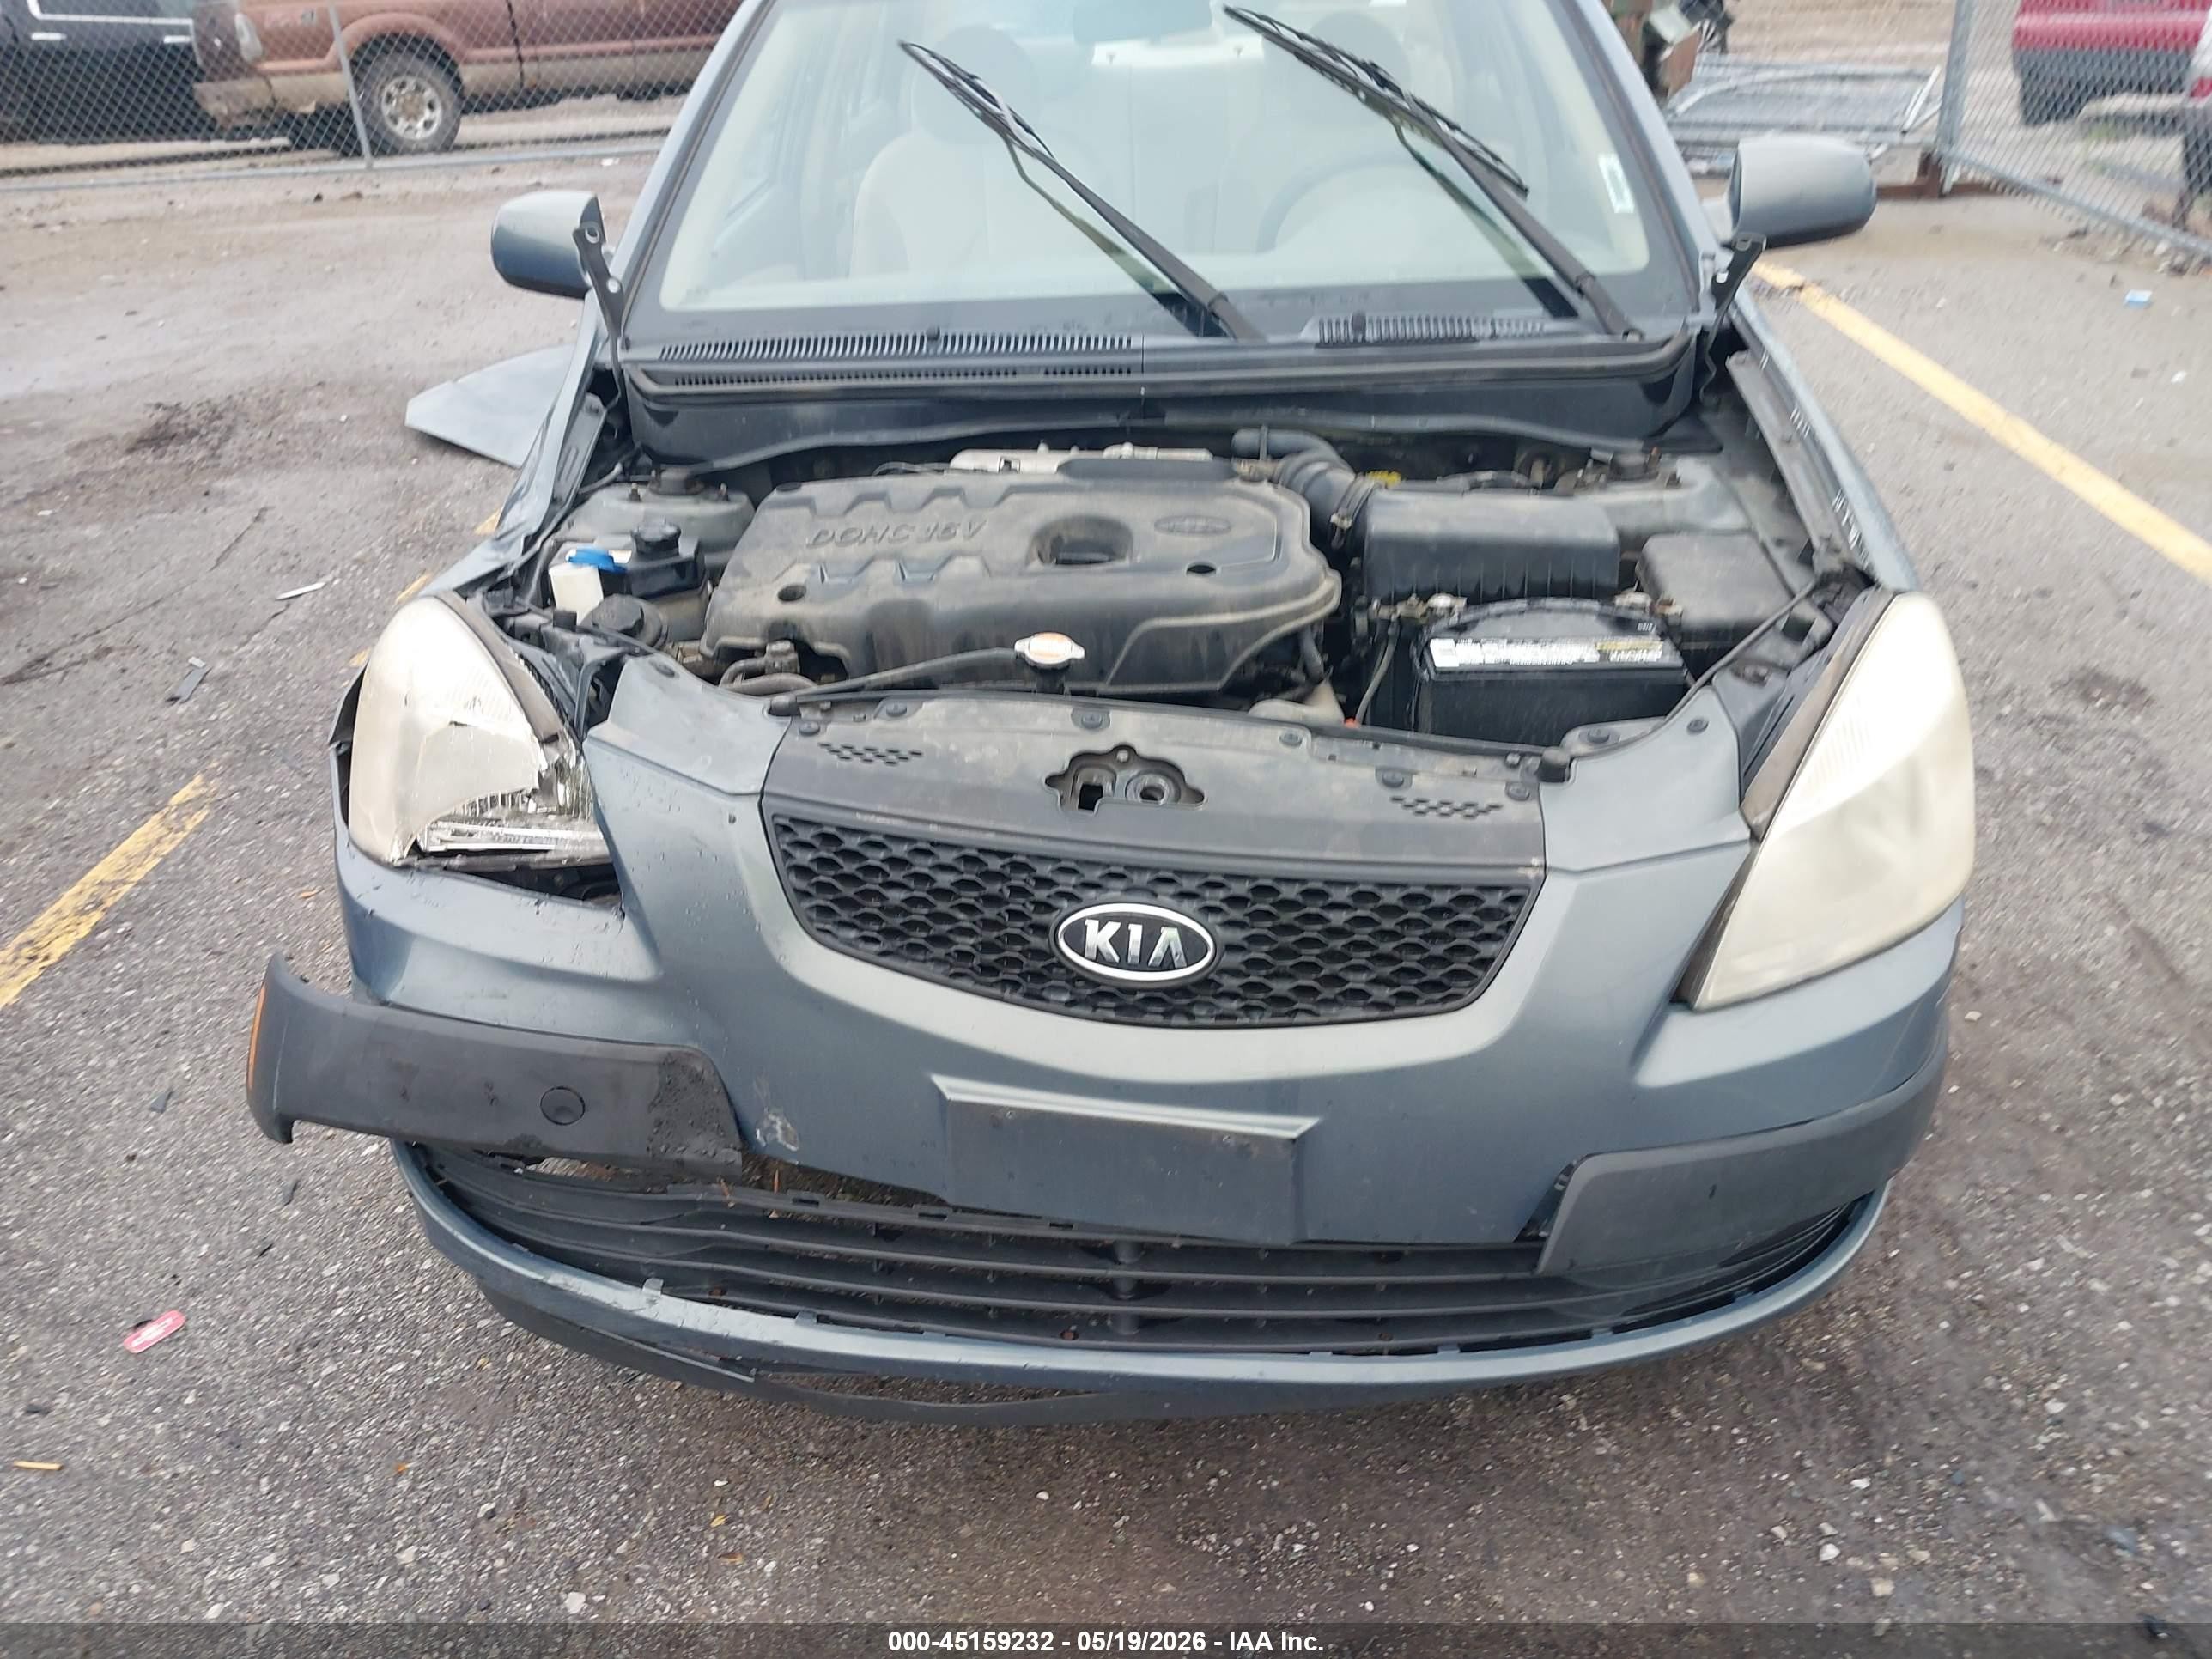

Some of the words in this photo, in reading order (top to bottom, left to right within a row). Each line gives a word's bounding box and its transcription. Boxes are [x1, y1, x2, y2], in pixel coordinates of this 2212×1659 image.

[805, 523, 915, 550] DOHC
[921, 518, 988, 544] 16V
[1085, 918, 1188, 969] KIA
